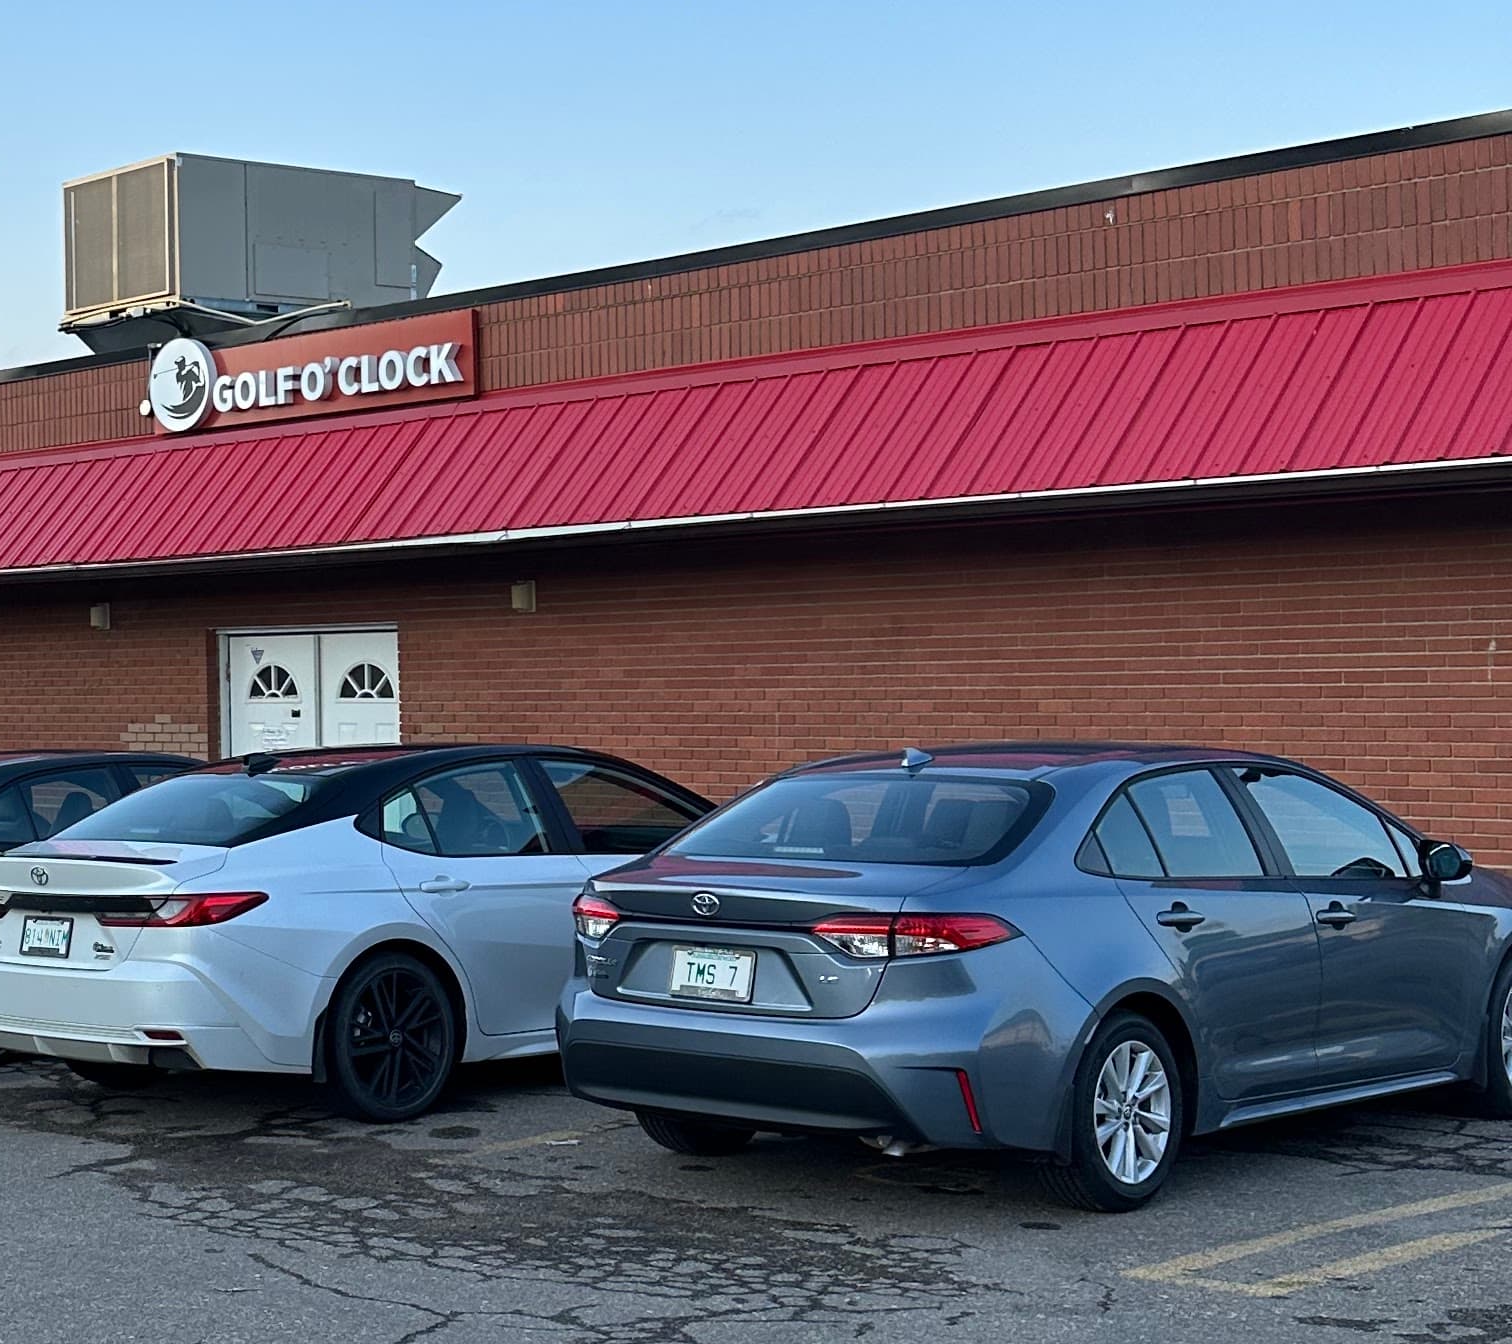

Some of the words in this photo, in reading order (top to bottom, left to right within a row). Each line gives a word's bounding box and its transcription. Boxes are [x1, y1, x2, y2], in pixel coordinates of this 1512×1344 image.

[212, 366, 295, 413] GOLF
[300, 342, 464, 401] O'CLOCK
[24, 927, 44, 945] 814
[49, 929, 69, 947] NIM
[687, 961, 717, 985] TMS
[729, 965, 738, 987] 7
